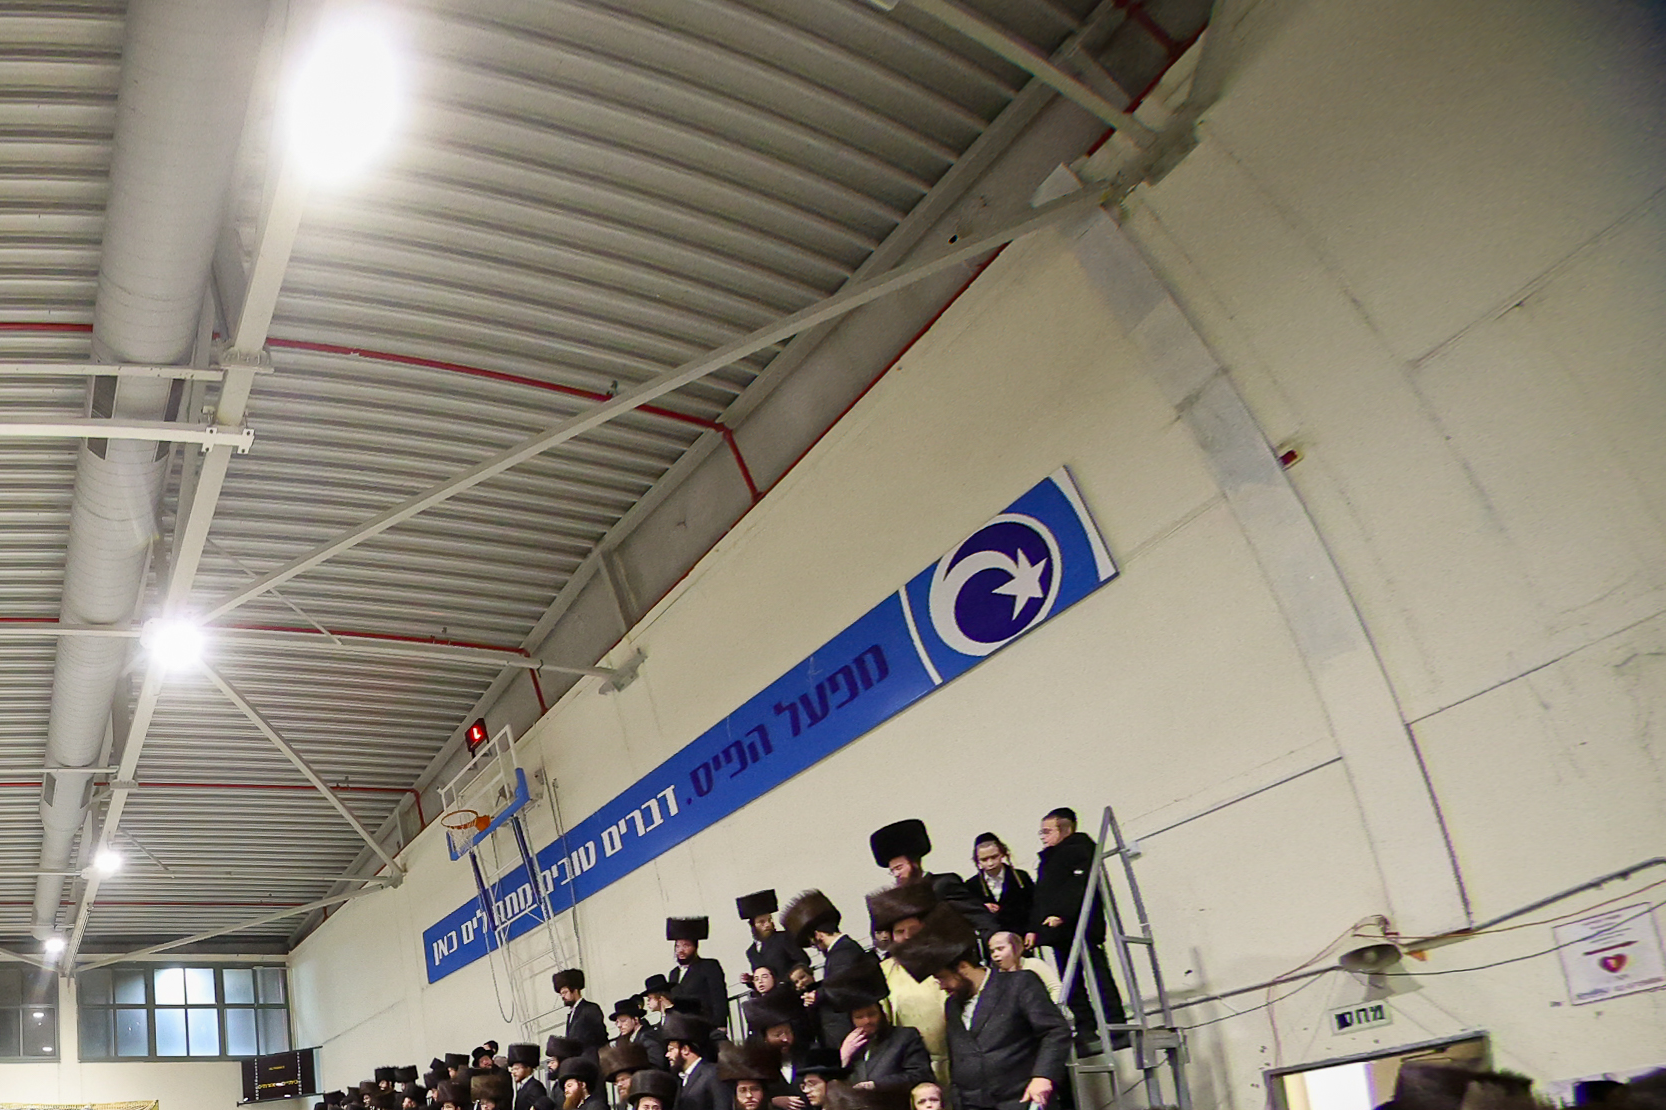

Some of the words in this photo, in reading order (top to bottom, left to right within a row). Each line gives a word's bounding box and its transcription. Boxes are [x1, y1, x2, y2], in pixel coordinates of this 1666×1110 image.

[772, 644, 890, 738] מפעל
[686, 723, 774, 805] הפיס.
[600, 784, 679, 858] דברים
[432, 930, 458, 966] כאן
